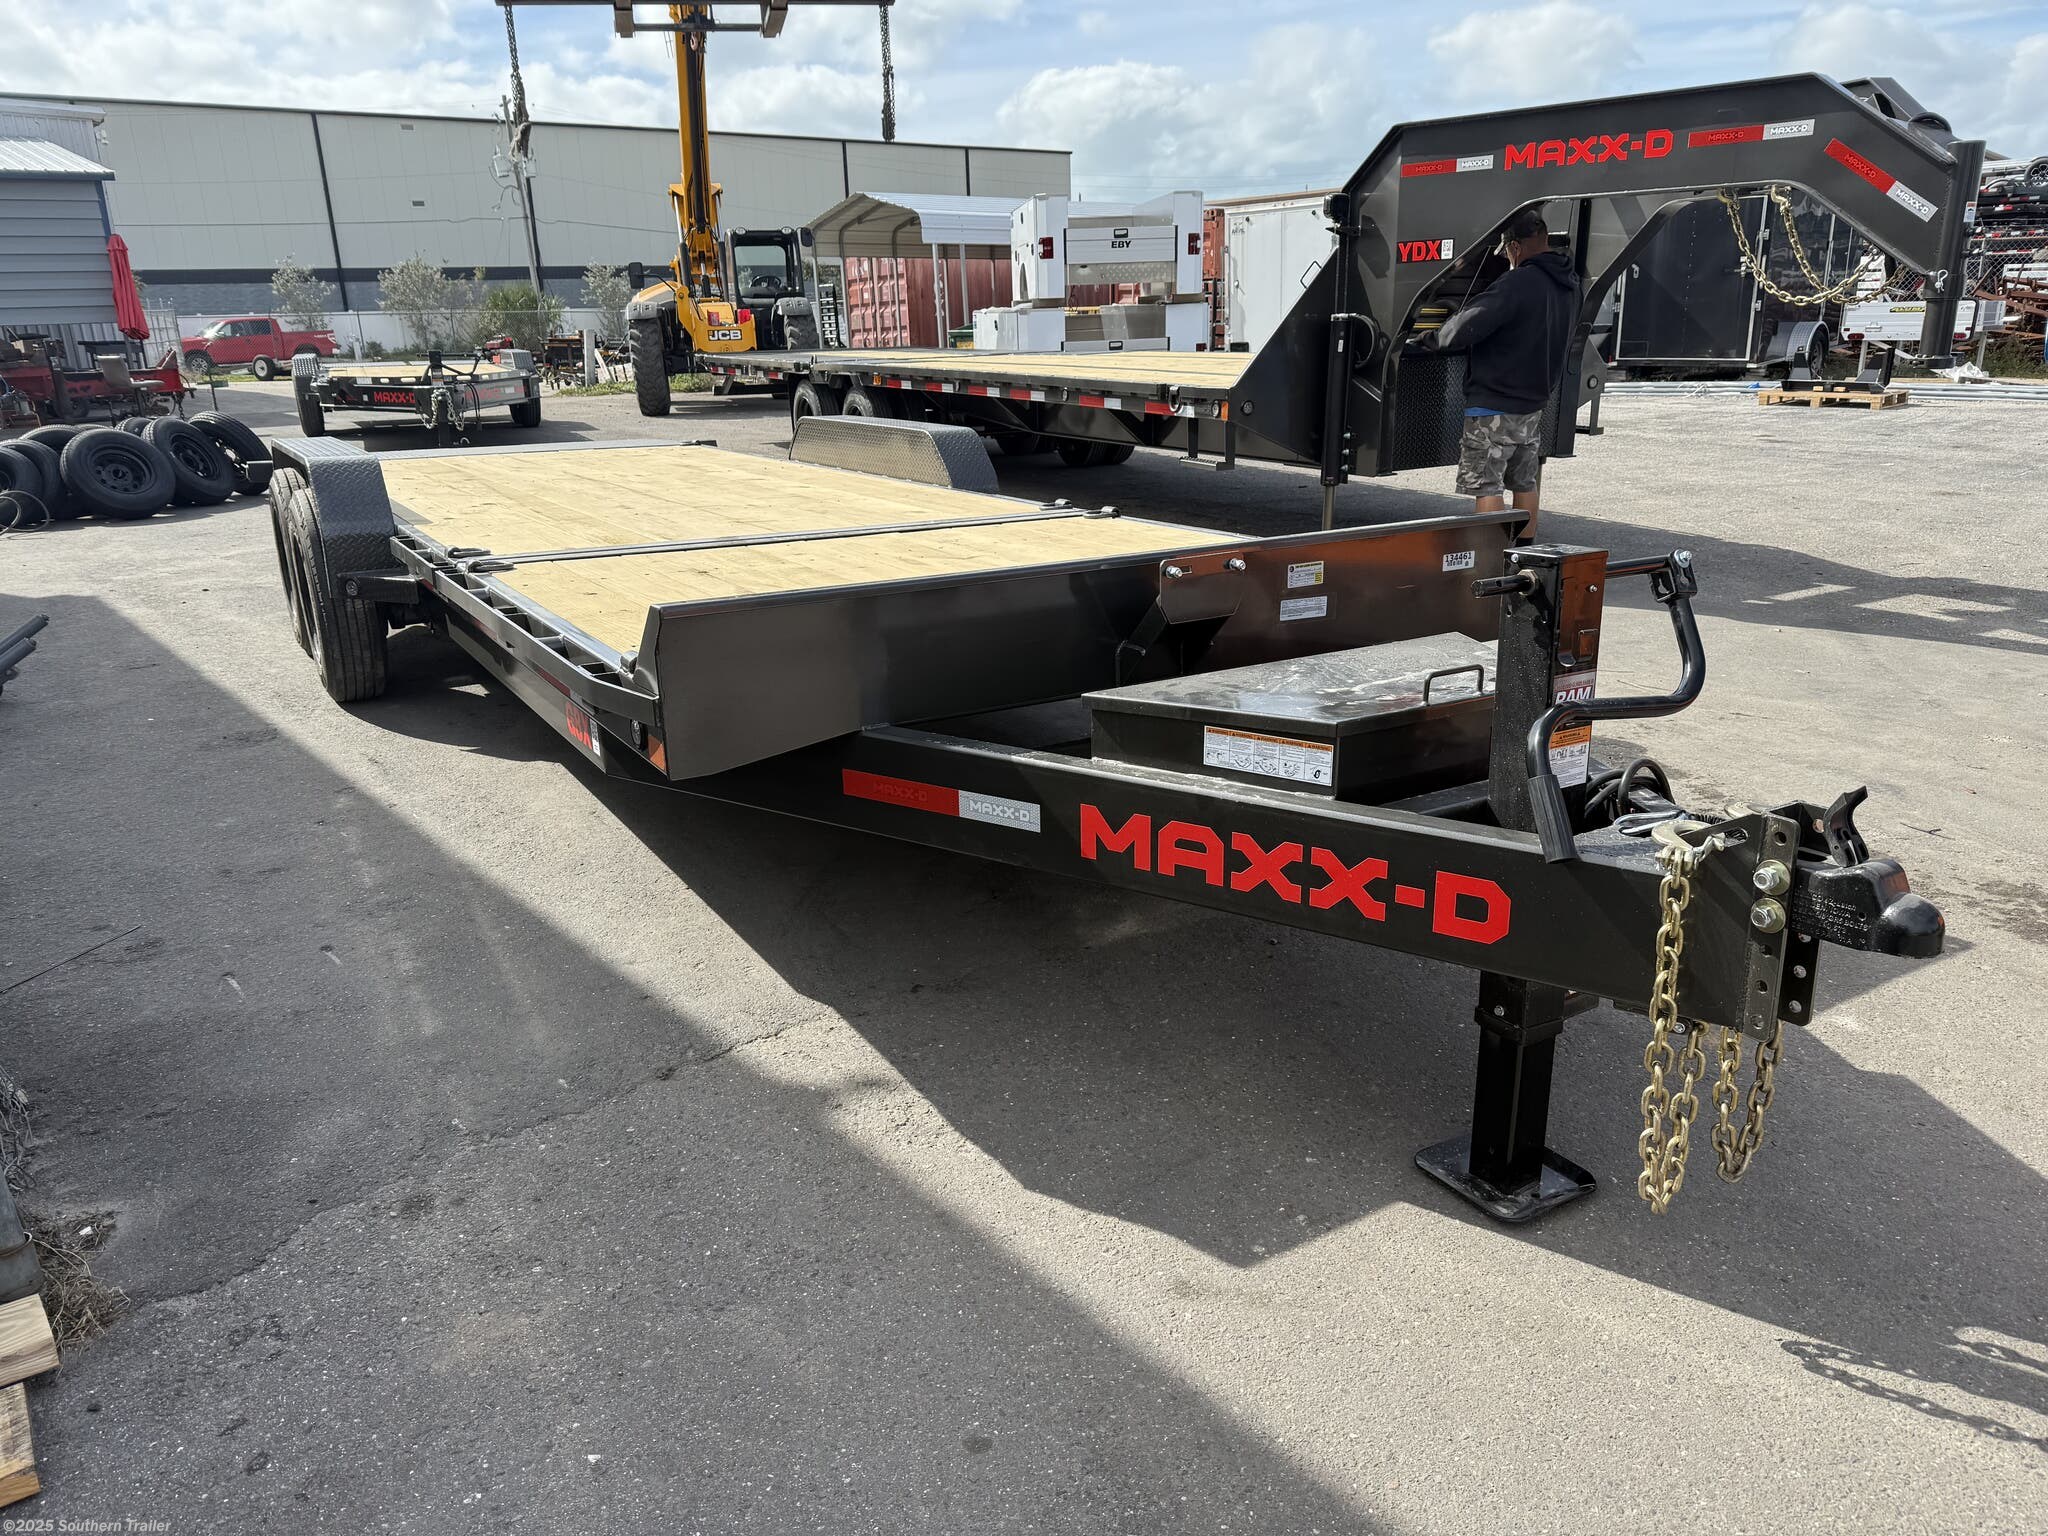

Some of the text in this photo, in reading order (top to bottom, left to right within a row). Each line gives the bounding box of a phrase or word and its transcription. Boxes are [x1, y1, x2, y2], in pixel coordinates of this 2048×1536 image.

[1770, 125, 1809, 135] MAXX-D
[1504, 128, 1674, 171] MAXX-D
[1843, 153, 1930, 215] MAXX-D MAXX-D
[1111, 240, 1131, 248] EBY
[1398, 240, 1441, 262] YDX
[708, 330, 742, 340] JCB
[1445, 552, 1472, 563] 134461
[872, 781, 1030, 822] MAXX-D MAXX-D
[1080, 803, 1512, 945] MAXX-D
